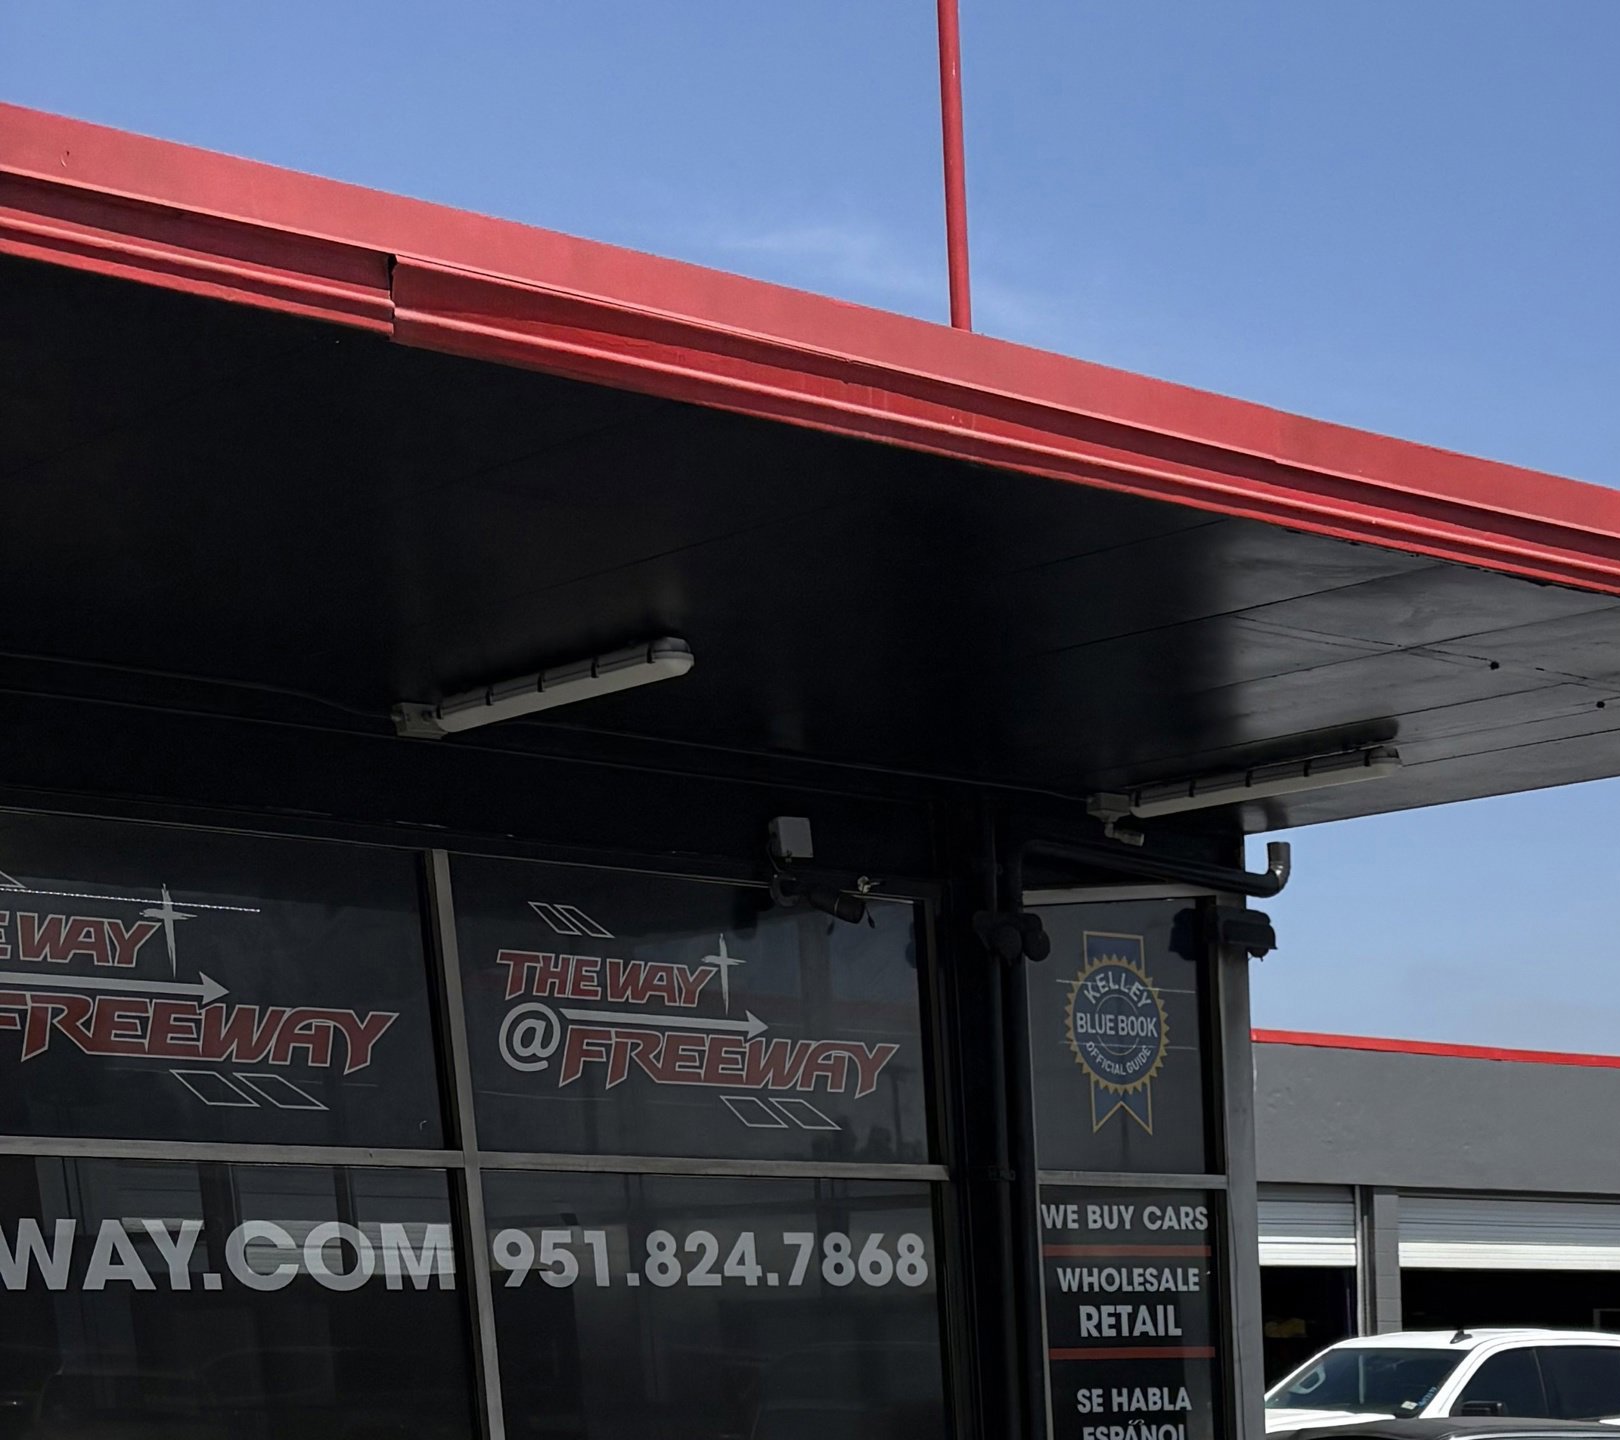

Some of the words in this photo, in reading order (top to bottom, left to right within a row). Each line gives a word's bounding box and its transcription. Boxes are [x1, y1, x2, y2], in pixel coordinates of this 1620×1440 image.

[17, 912, 161, 967] WAY
[497, 949, 601, 1000] THE
[606, 958, 718, 1007] WAY
[1084, 971, 1151, 1007] KELLEY
[1076, 1012, 1115, 1035] BLUE
[1118, 1015, 1158, 1038] BOOK
[1086, 1041, 1126, 1075] OFFICIAL
[1126, 1045, 1151, 1073] GUIDE
[1041, 1204, 1079, 1229] WE
[1088, 1205, 1133, 1230] BUY
[1143, 1206, 1208, 1230] CARS
[0, 1218, 456, 1291] WAY.COM
[492, 1228, 929, 1288] 951.824.7868
[1057, 1267, 1200, 1292] WHOLESALE
[1079, 1305, 1182, 1338] RETAIL
[1077, 1388, 1103, 1414] SE
[1112, 1387, 1192, 1413] HABLA
